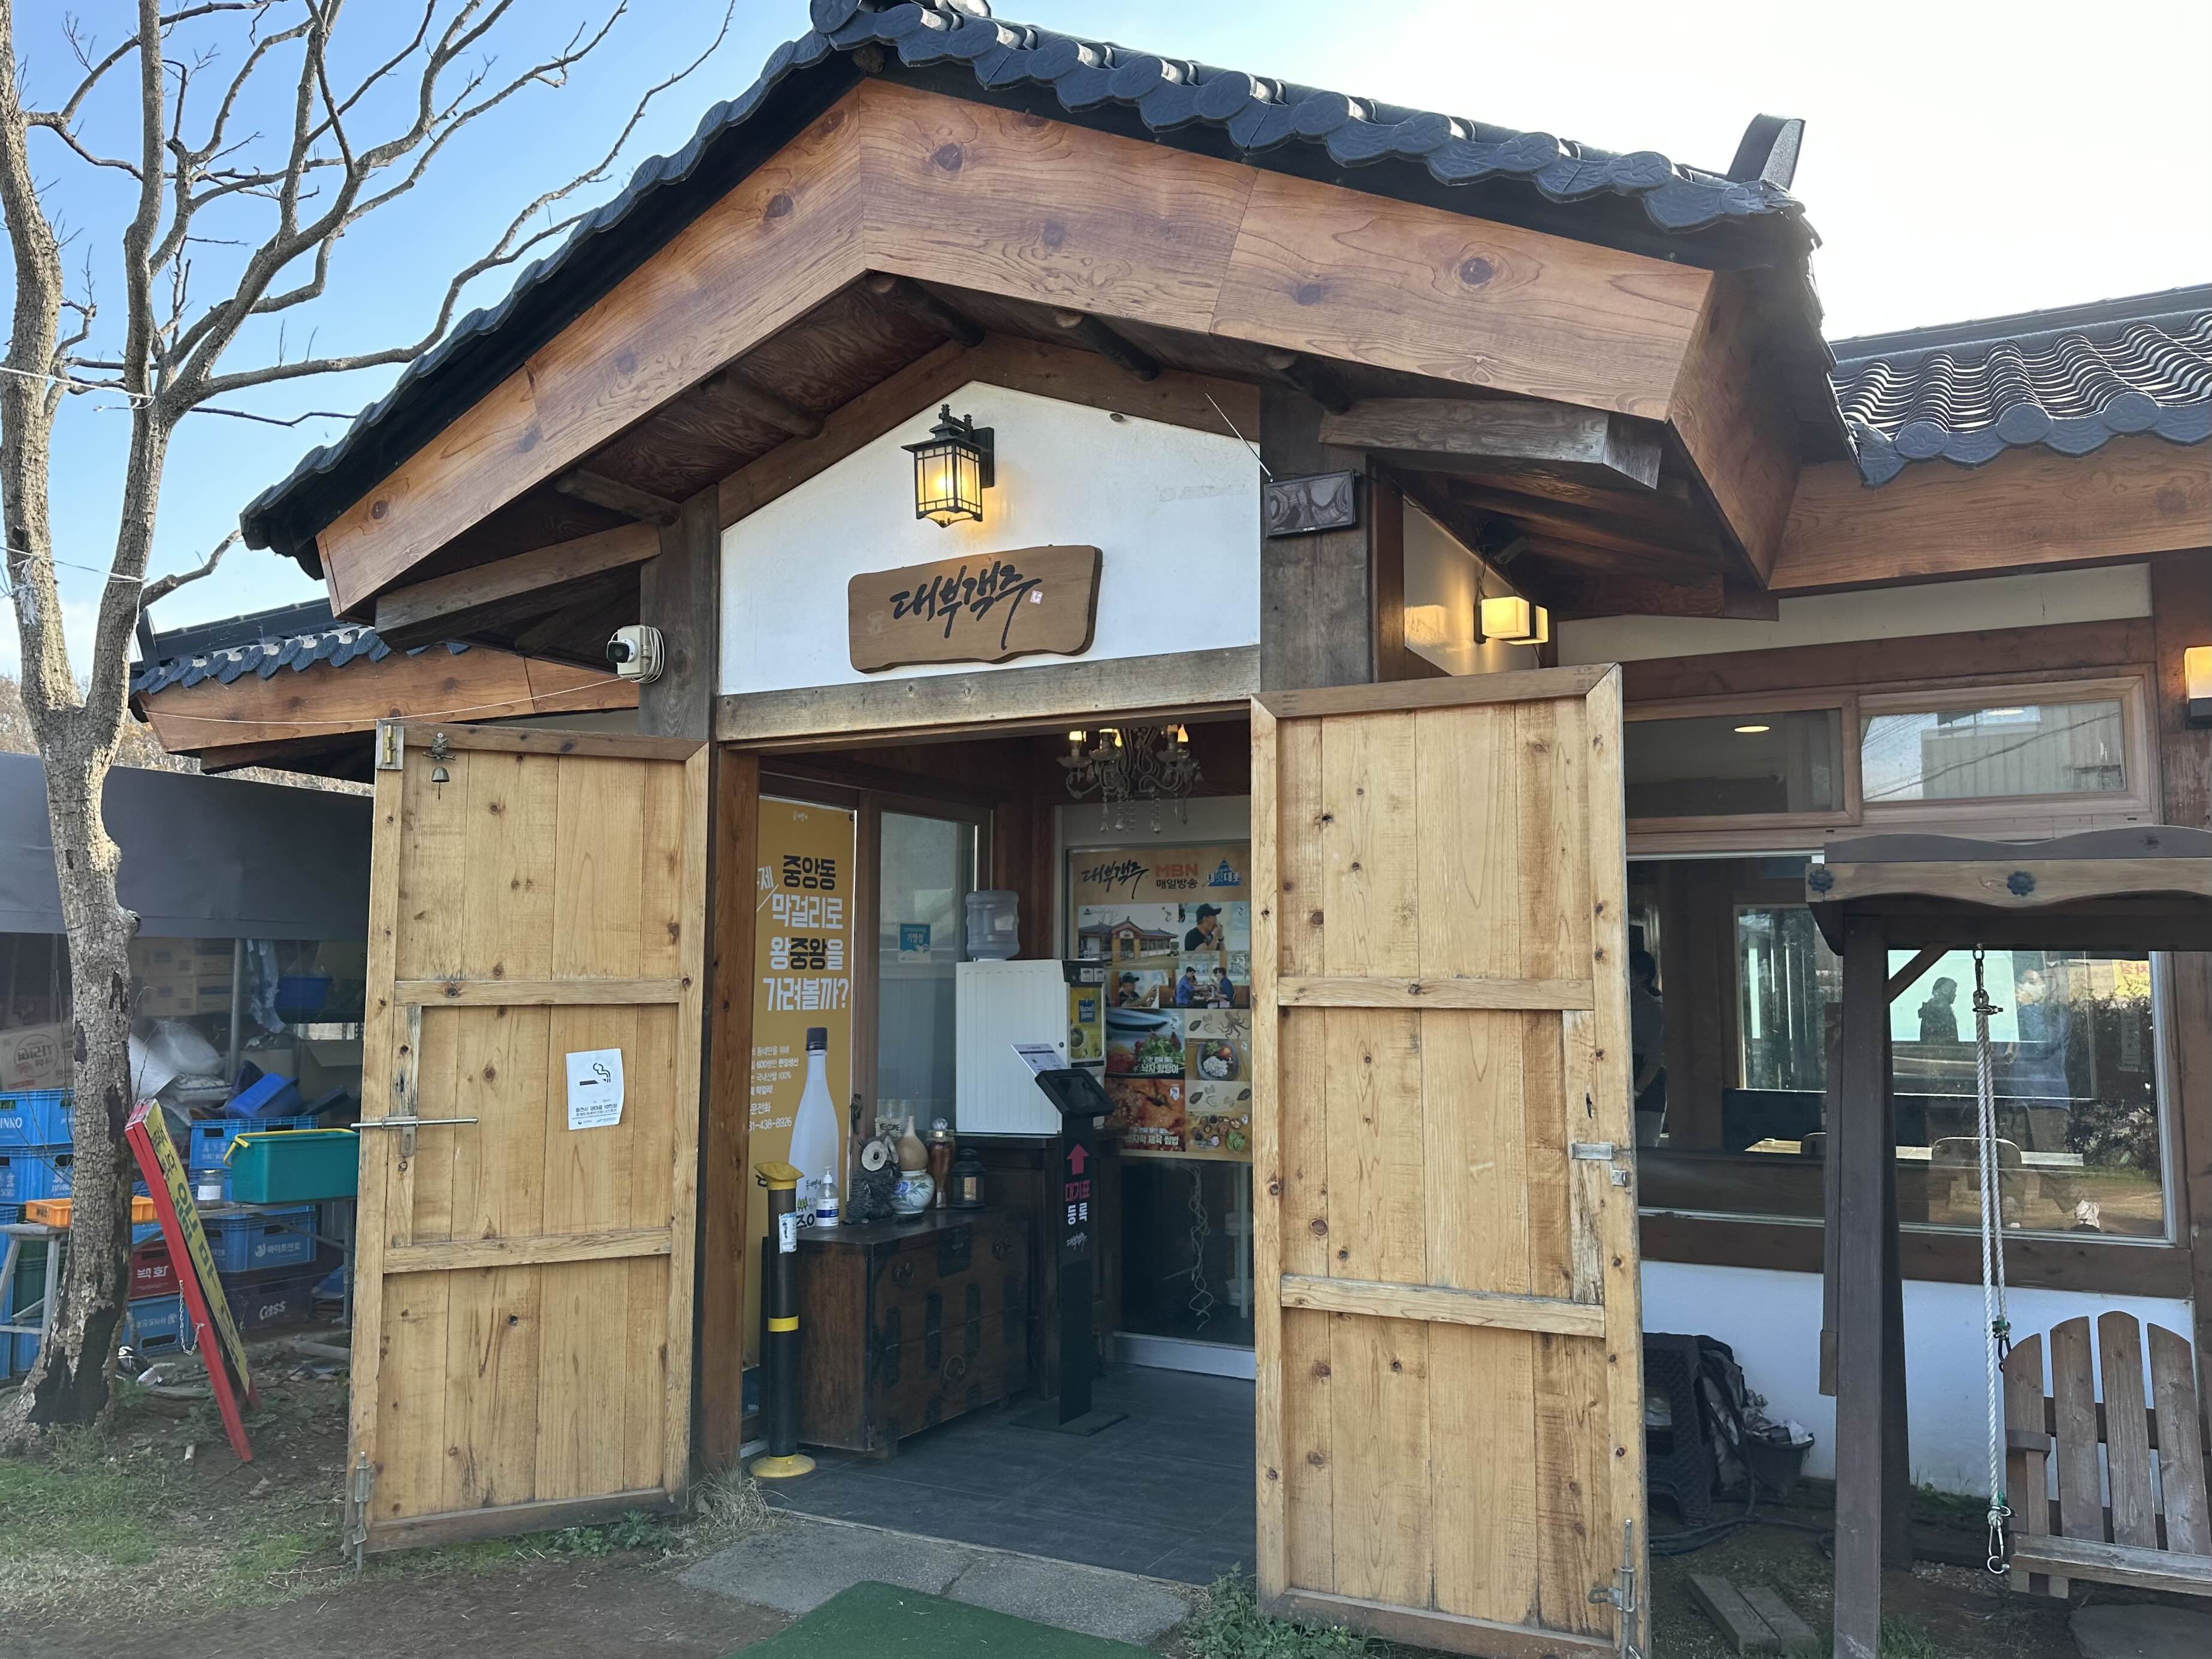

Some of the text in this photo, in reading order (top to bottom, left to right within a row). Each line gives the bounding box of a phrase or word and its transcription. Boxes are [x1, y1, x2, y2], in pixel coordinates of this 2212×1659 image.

[756, 865, 774, 890] 제
[783, 854, 836, 891] 중앙동
[1155, 863, 1199, 877] MBN
[1156, 878, 1199, 889] 매일방송
[772, 893, 844, 930] 막걸리로
[769, 936, 844, 971] 왕중왕을
[763, 977, 849, 1011] 가려볼까?
[1066, 1180, 1090, 1202] 대기표
[137, 1265, 169, 1279] 백화
[258, 1300, 286, 1321] Cass
